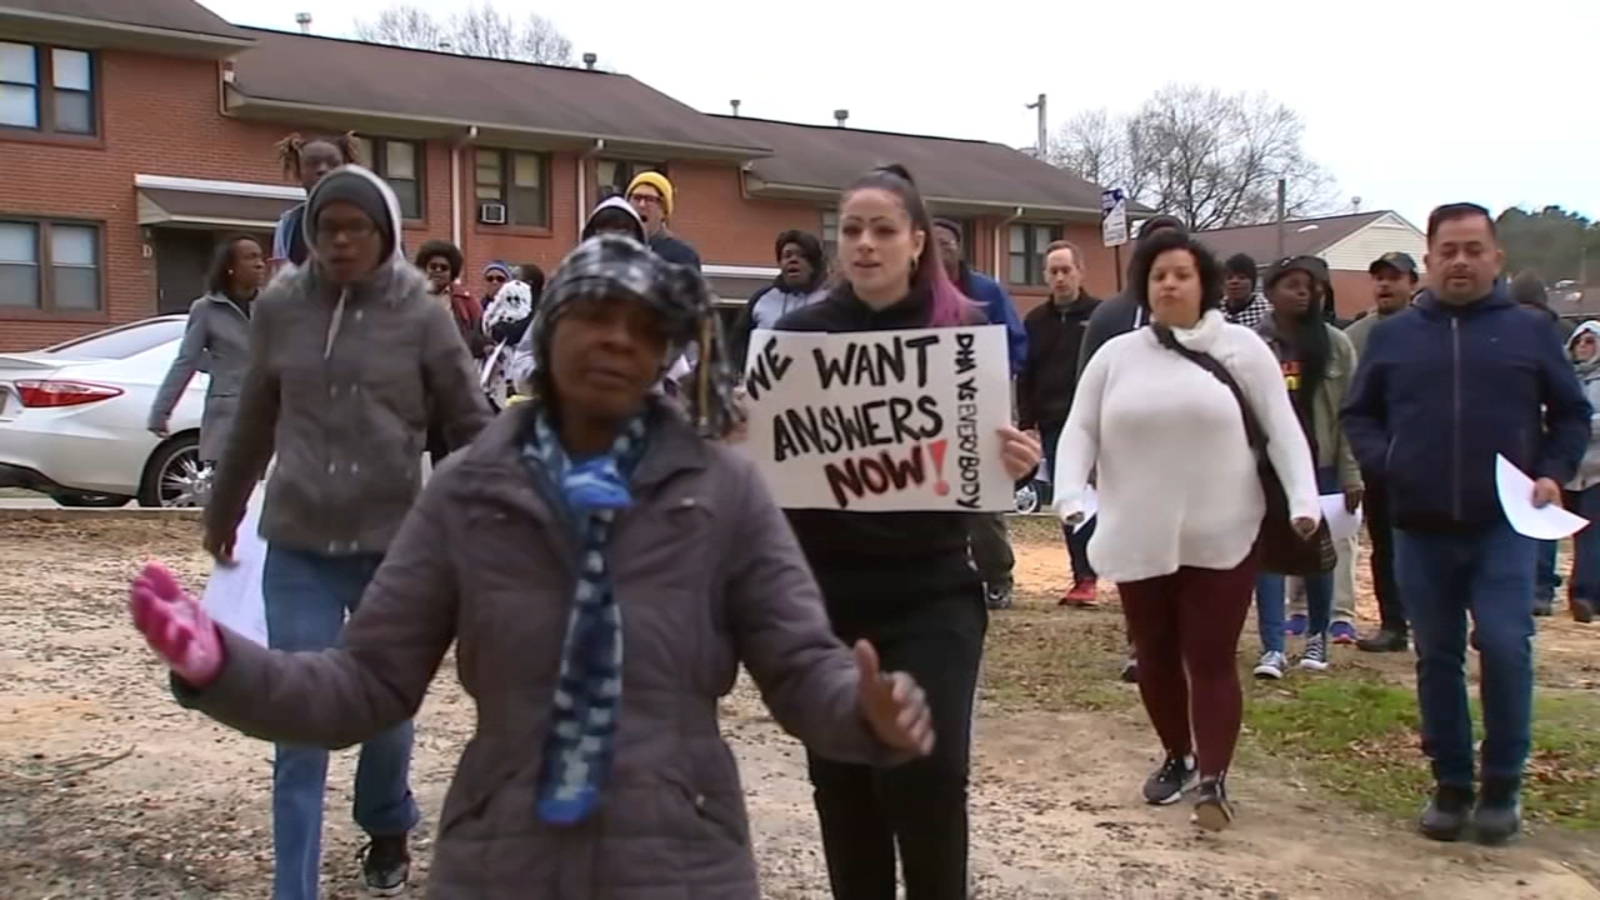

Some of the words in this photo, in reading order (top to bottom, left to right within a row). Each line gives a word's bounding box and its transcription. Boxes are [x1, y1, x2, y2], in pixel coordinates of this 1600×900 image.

[143, 244, 153, 258] D
[746, 336, 793, 401] WE
[812, 334, 940, 389] WANT
[955, 332, 977, 375] DHA
[956, 376, 978, 401] VS
[773, 395, 943, 462] ANSWERS
[956, 402, 982, 509] EVERYBODY
[823, 440, 948, 508] NOW!
